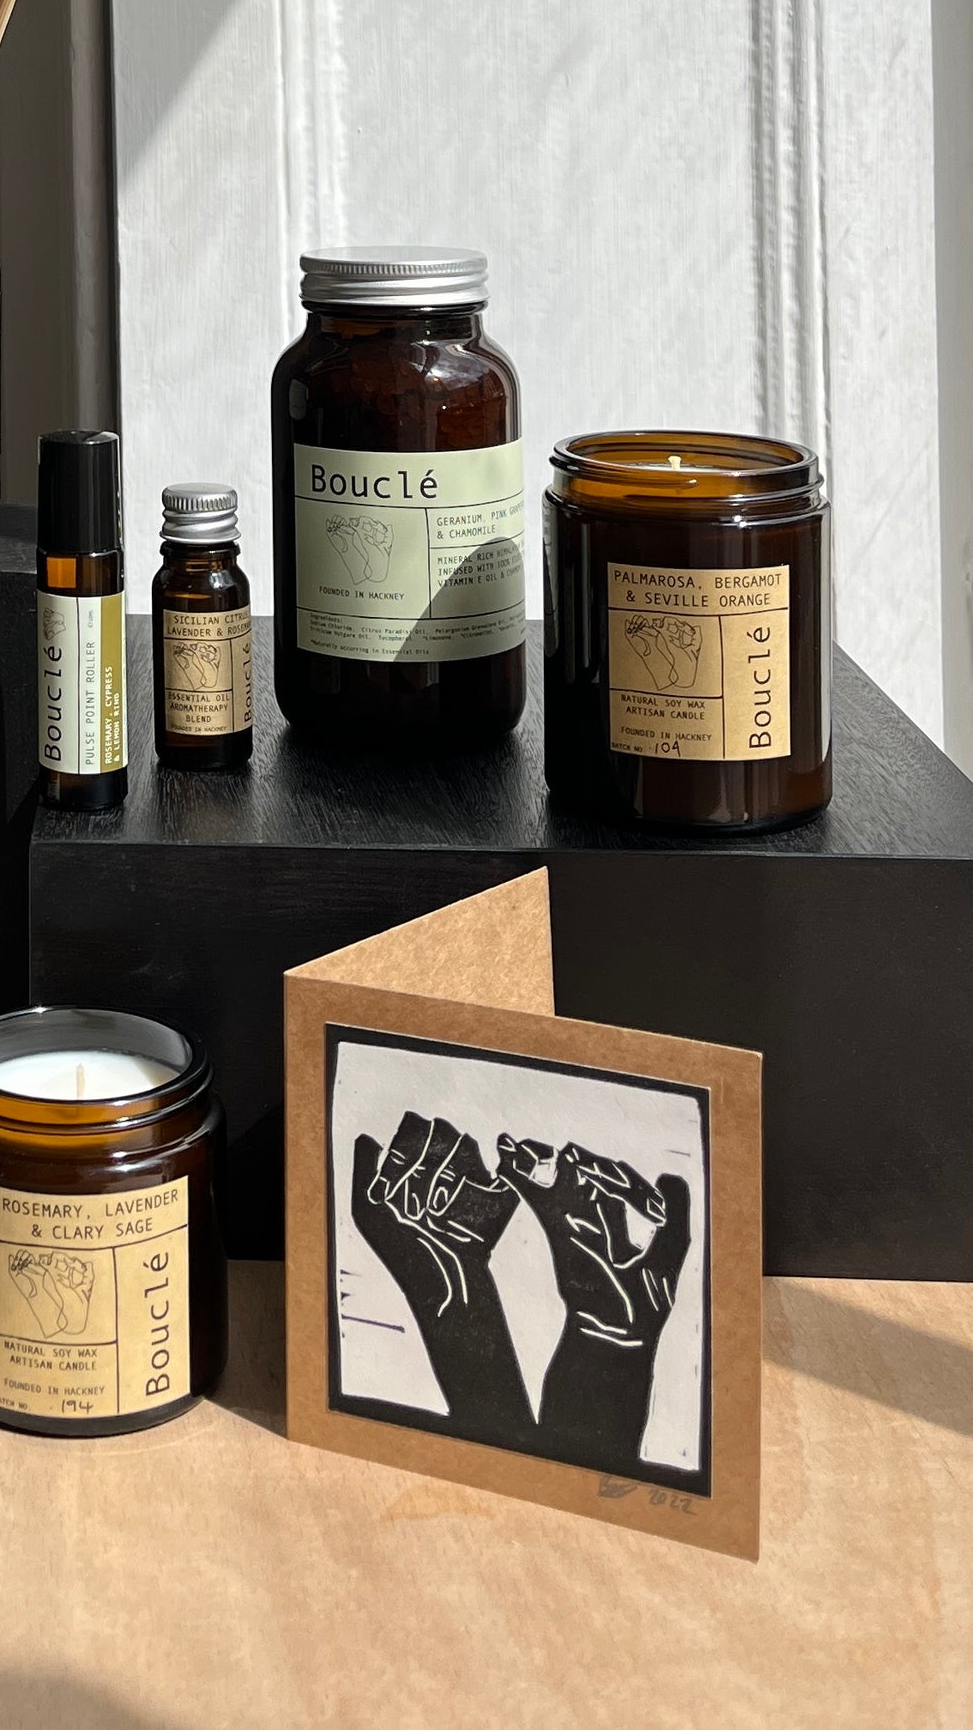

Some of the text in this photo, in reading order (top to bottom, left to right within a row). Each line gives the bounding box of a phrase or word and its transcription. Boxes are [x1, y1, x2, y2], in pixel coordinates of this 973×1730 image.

[311, 464, 438, 499] Bouclé
[491, 510, 507, 520] PINK
[437, 525, 496, 539] & CHAMOMILE
[437, 552, 493, 565] MINERAL RICH
[438, 566, 473, 576] INFUSED
[477, 563, 493, 572] WITH
[438, 576, 473, 587] VITAMIN
[478, 576, 482, 584] E
[486, 574, 497, 582] OIL
[715, 573, 781, 589] BERGAMOT
[319, 586, 350, 597] FOUNDED
[369, 592, 404, 600] HACKNEY
[627, 590, 770, 607] & SEVILLE ORANGE
[174, 615, 219, 625] SICILIAN
[168, 627, 211, 637] LAVENDER
[217, 628, 223, 636] &
[105, 666, 113, 707] CYPRESS
[747, 626, 772, 749] Bouclé
[44, 645, 62, 761] Bouclé
[85, 642, 95, 765] PULSE POINT ROLLER
[168, 692, 210, 702] ESSENTIAL
[621, 694, 658, 706] NATURAL
[688, 701, 705, 709] WAX
[170, 703, 228, 712] AROMATHERAPY
[626, 706, 705, 720] ARTISAN CANDLE
[186, 715, 212, 723] BLEND
[621, 726, 655, 738] FOUNDED
[675, 733, 712, 741] HACKNEY
[612, 742, 630, 750] BATCH
[3, 1189, 178, 1219] ROSEMARY, LAVENDER
[31, 1217, 153, 1240] & CLARY SAGE
[144, 1252, 170, 1397] Bouclé
[4, 1341, 98, 1358] NATURAL SOY WAX
[10, 1355, 96, 1370] ARTISAN CANDLE
[4, 1378, 105, 1396] FOUNDED IN HACKNEY
[61, 1399, 93, 1414] 194
